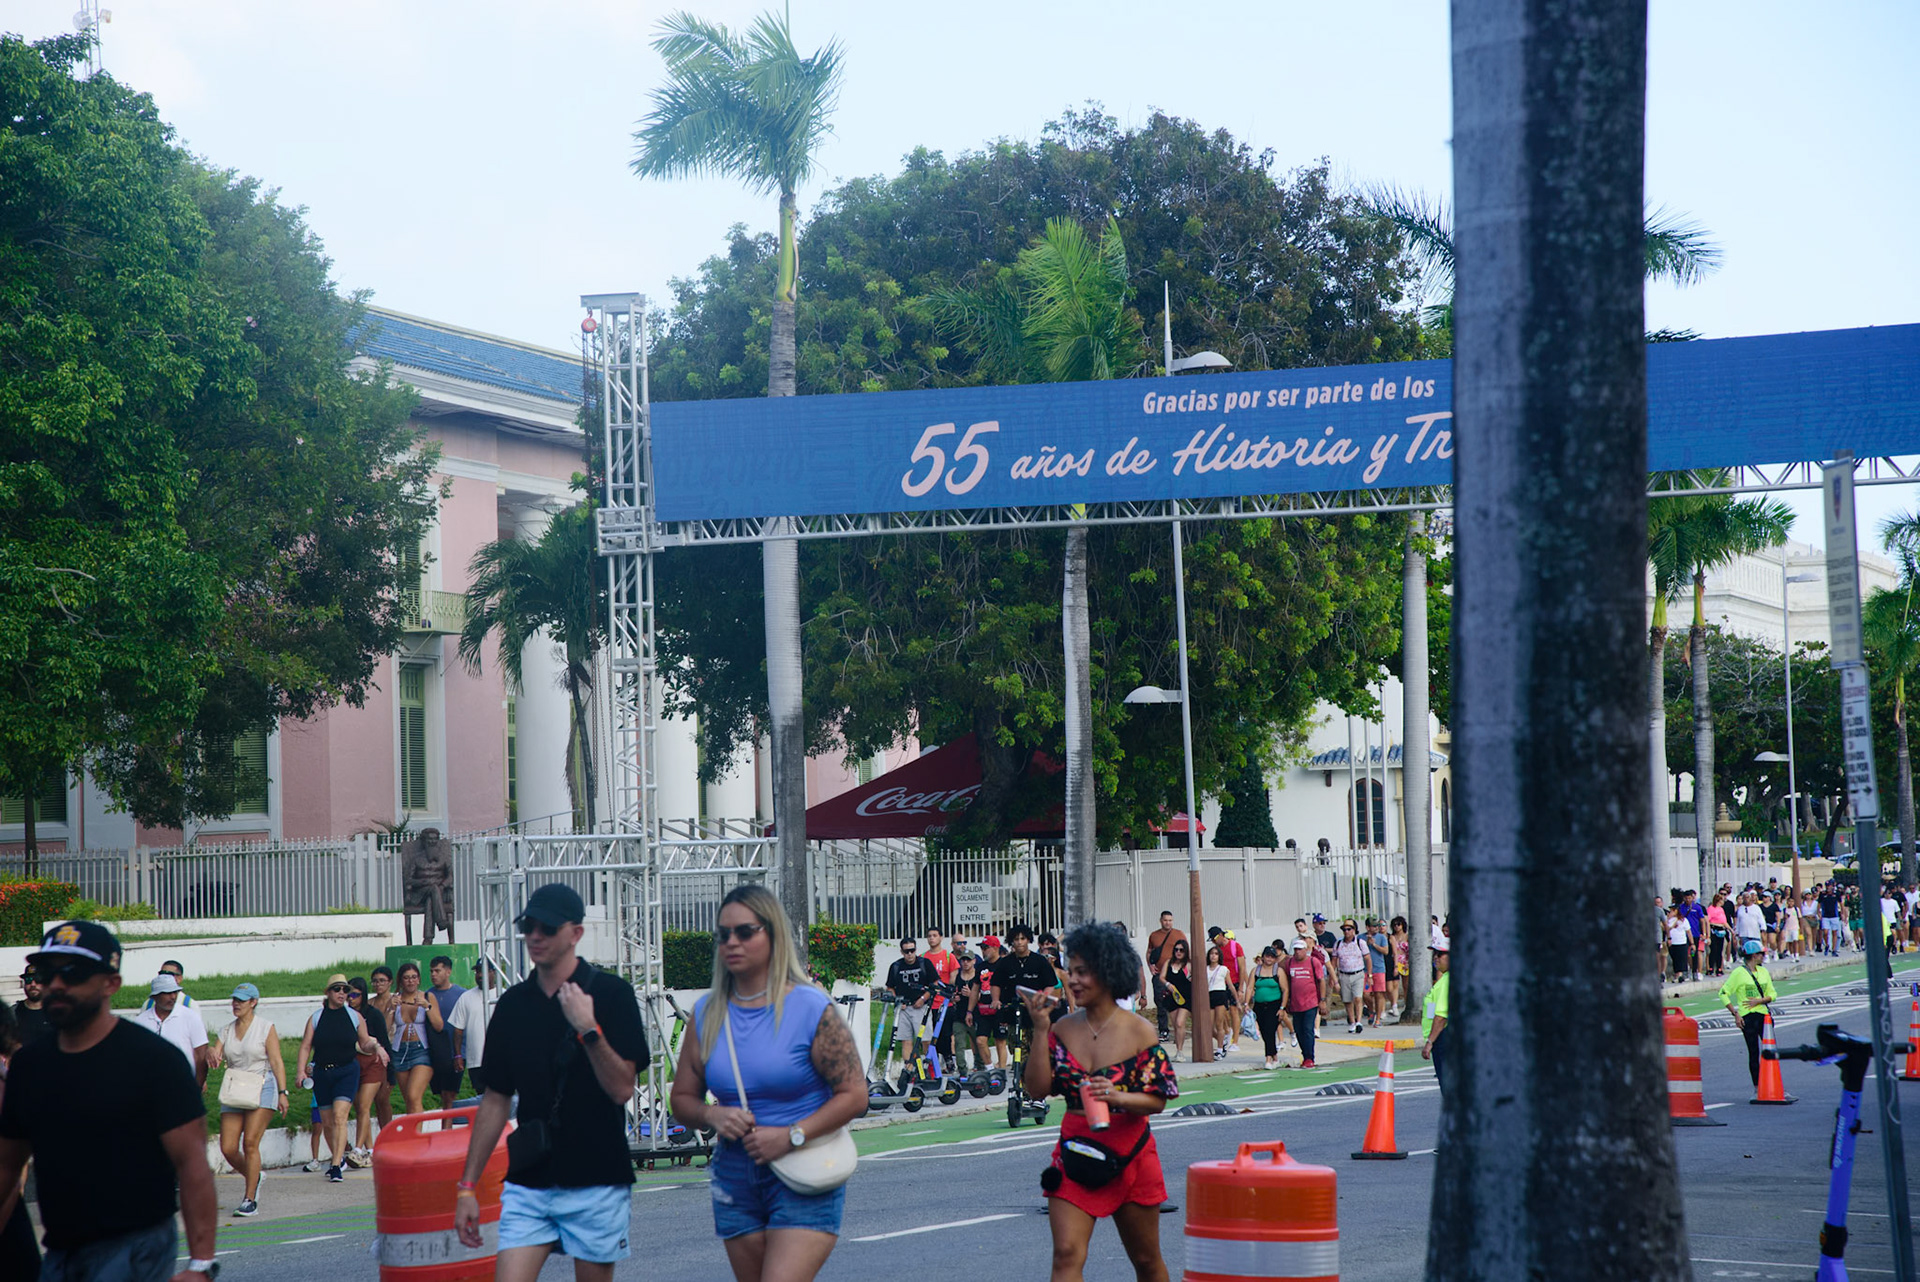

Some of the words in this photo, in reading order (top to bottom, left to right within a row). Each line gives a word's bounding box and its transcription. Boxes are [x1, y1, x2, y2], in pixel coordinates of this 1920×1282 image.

[1143, 388, 1218, 415] Gracias
[1223, 389, 1262, 414] por
[1266, 387, 1301, 407] ser
[1304, 381, 1364, 409] parte
[1370, 377, 1397, 401] de
[1402, 376, 1436, 399] los
[901, 420, 1000, 498] 55
[1010, 445, 1096, 480] años
[1106, 436, 1158, 476] de
[1172, 423, 1361, 476] Historia
[1362, 433, 1399, 484] y
[855, 783, 982, 817] Coca-C
[956, 894, 989, 902] SOLAMENTE
[961, 885, 984, 893] SALIDA
